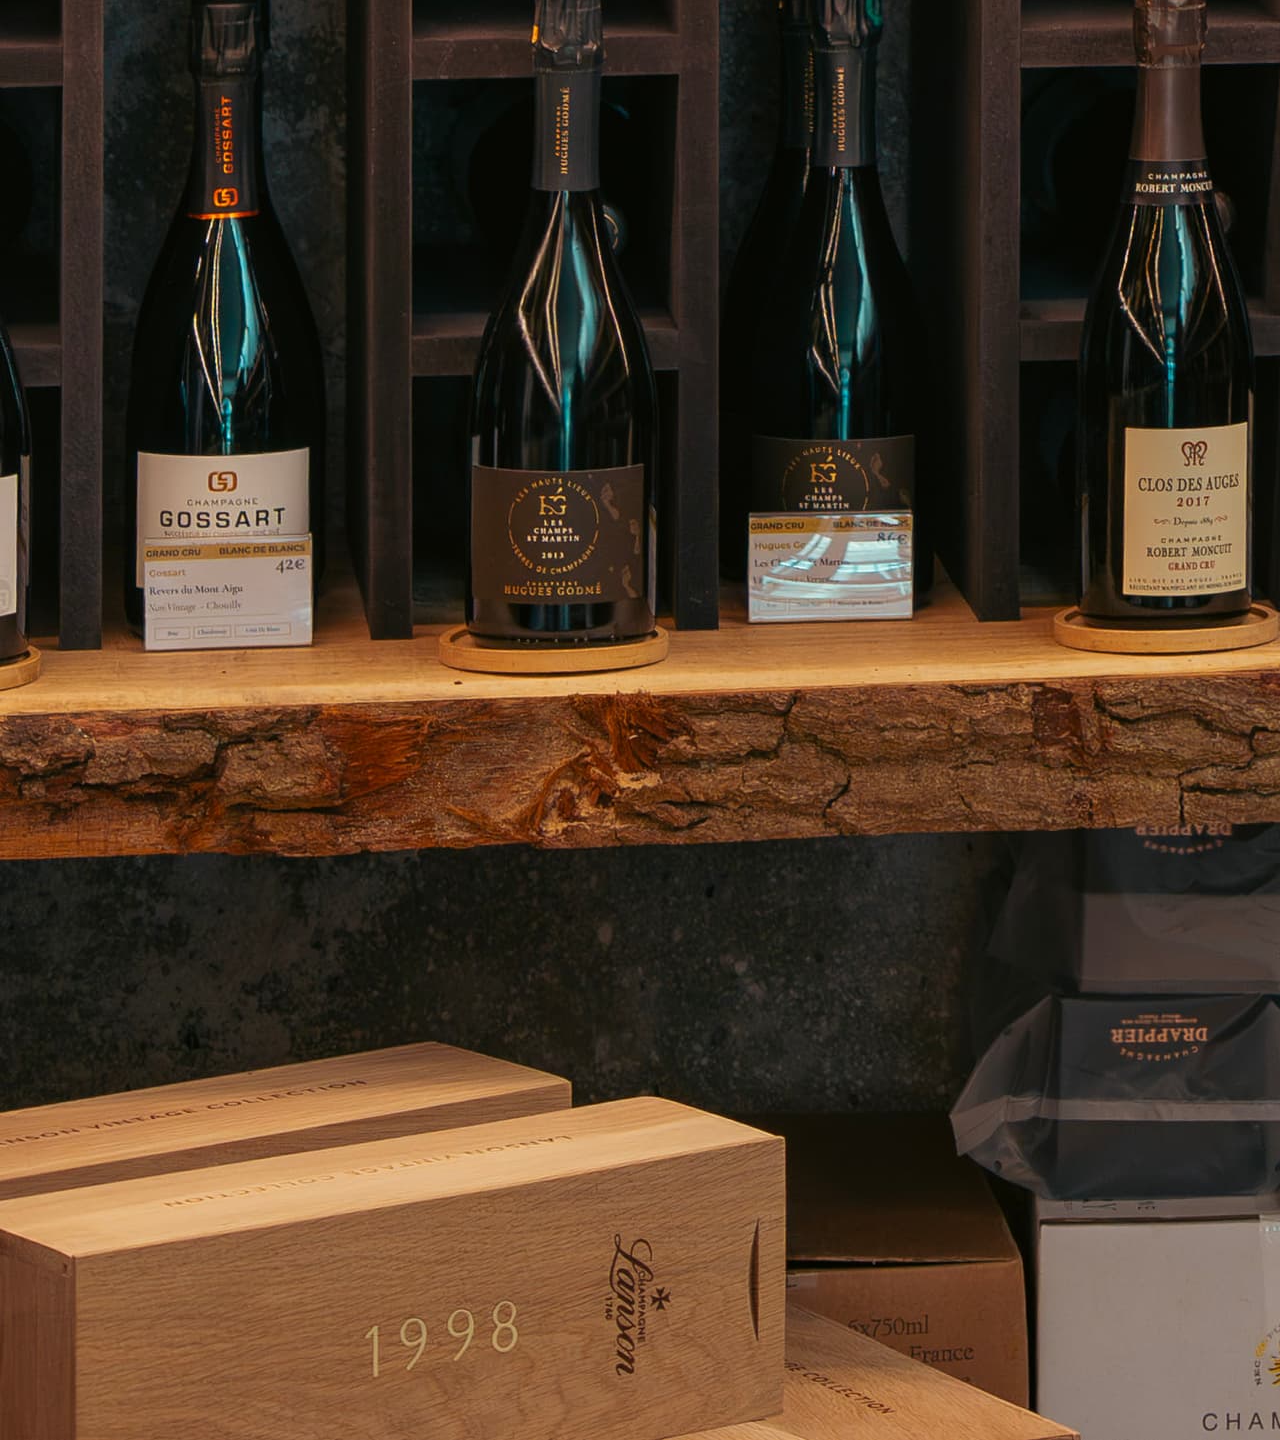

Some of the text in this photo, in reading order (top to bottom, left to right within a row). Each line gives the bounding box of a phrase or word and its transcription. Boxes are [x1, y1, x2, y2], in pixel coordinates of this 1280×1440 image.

[222, 96, 233, 174] GOSSART
[1148, 171, 1208, 180] CHAMPAGNE
[1136, 183, 1176, 194] ROBERT
[1138, 474, 1239, 492] CLOS DES AUGES
[187, 498, 258, 506] CHAMPAGNE
[1177, 496, 1210, 507] 2017
[160, 508, 285, 528] GOSSART
[146, 549, 180, 557] GRAND
[219, 545, 305, 555] BLANC DE BLANCS
[1147, 544, 1232, 557] ROBERT MONCUIT
[276, 559, 305, 574] 42€
[1168, 561, 1215, 571] GRAND CRU
[182, 586, 218, 594] du Mont
[504, 585, 552, 596] HUGUES
[1111, 1027, 1208, 1043] DRAPPIER
[206, 1079, 367, 1110] COLLECTION
[609, 1233, 654, 1376] Lanson
[638, 1271, 646, 1343] CHAMPAGNE
[365, 1301, 518, 1378] 1998
[911, 1346, 974, 1361] France
[802, 1371, 895, 1414] COLLECTION
